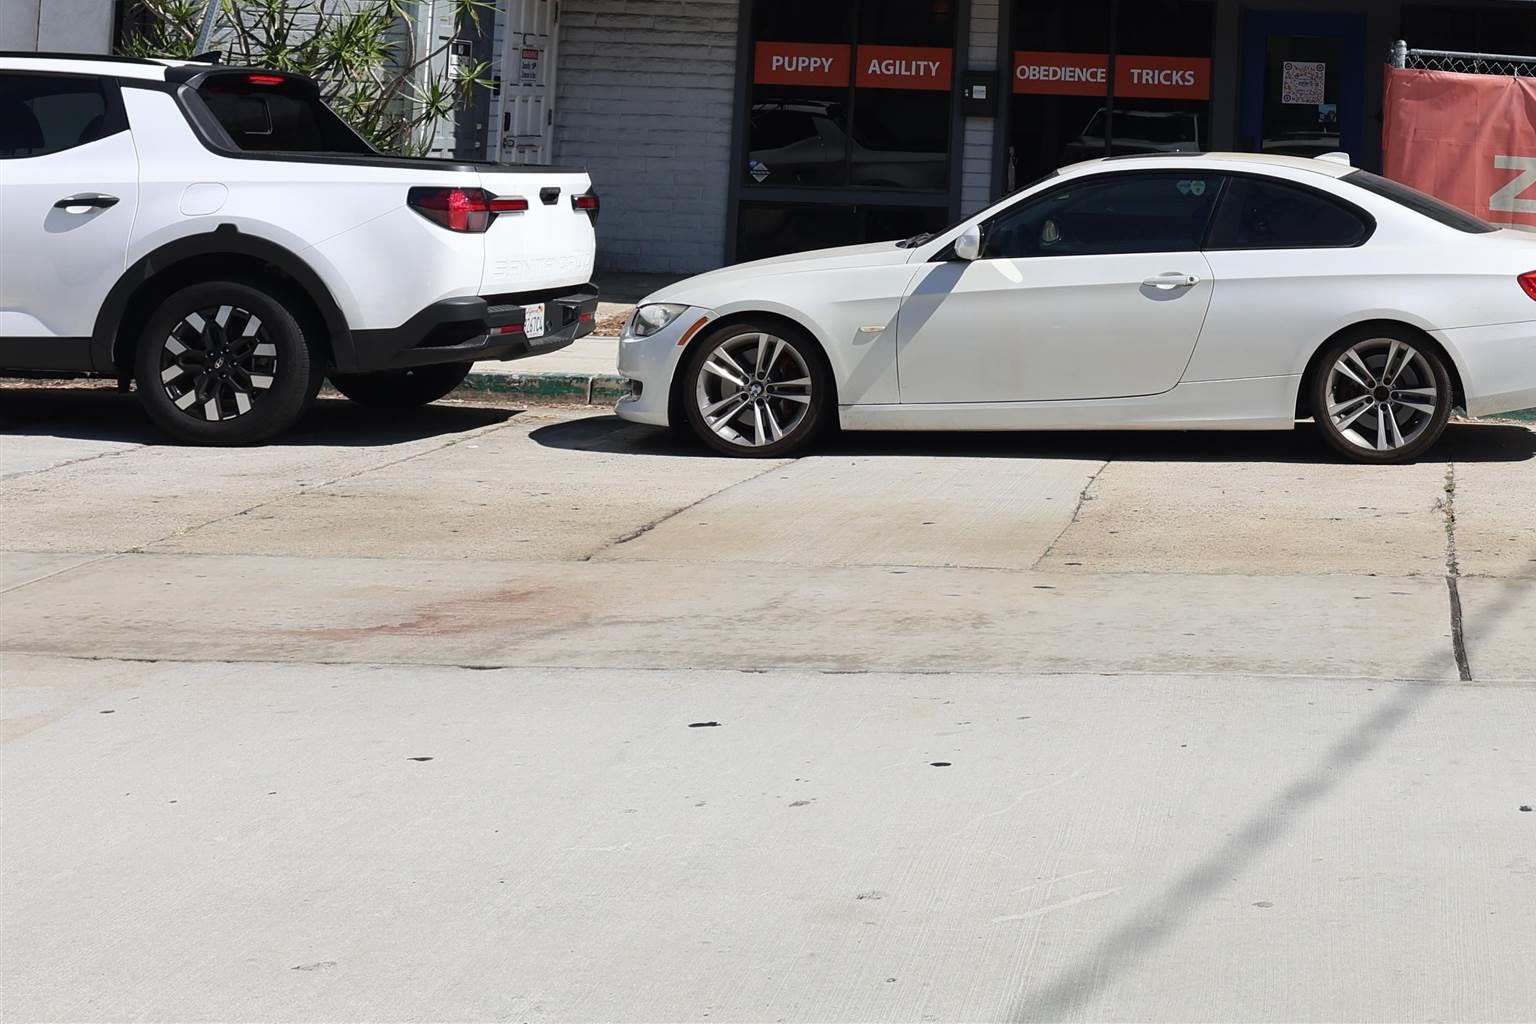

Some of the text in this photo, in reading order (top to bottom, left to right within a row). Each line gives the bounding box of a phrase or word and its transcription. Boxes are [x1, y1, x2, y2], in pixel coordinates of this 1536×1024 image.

[771, 54, 941, 78] PUPPY AGILITY
[1015, 64, 1195, 87] OBEDIENCE TRICKS
